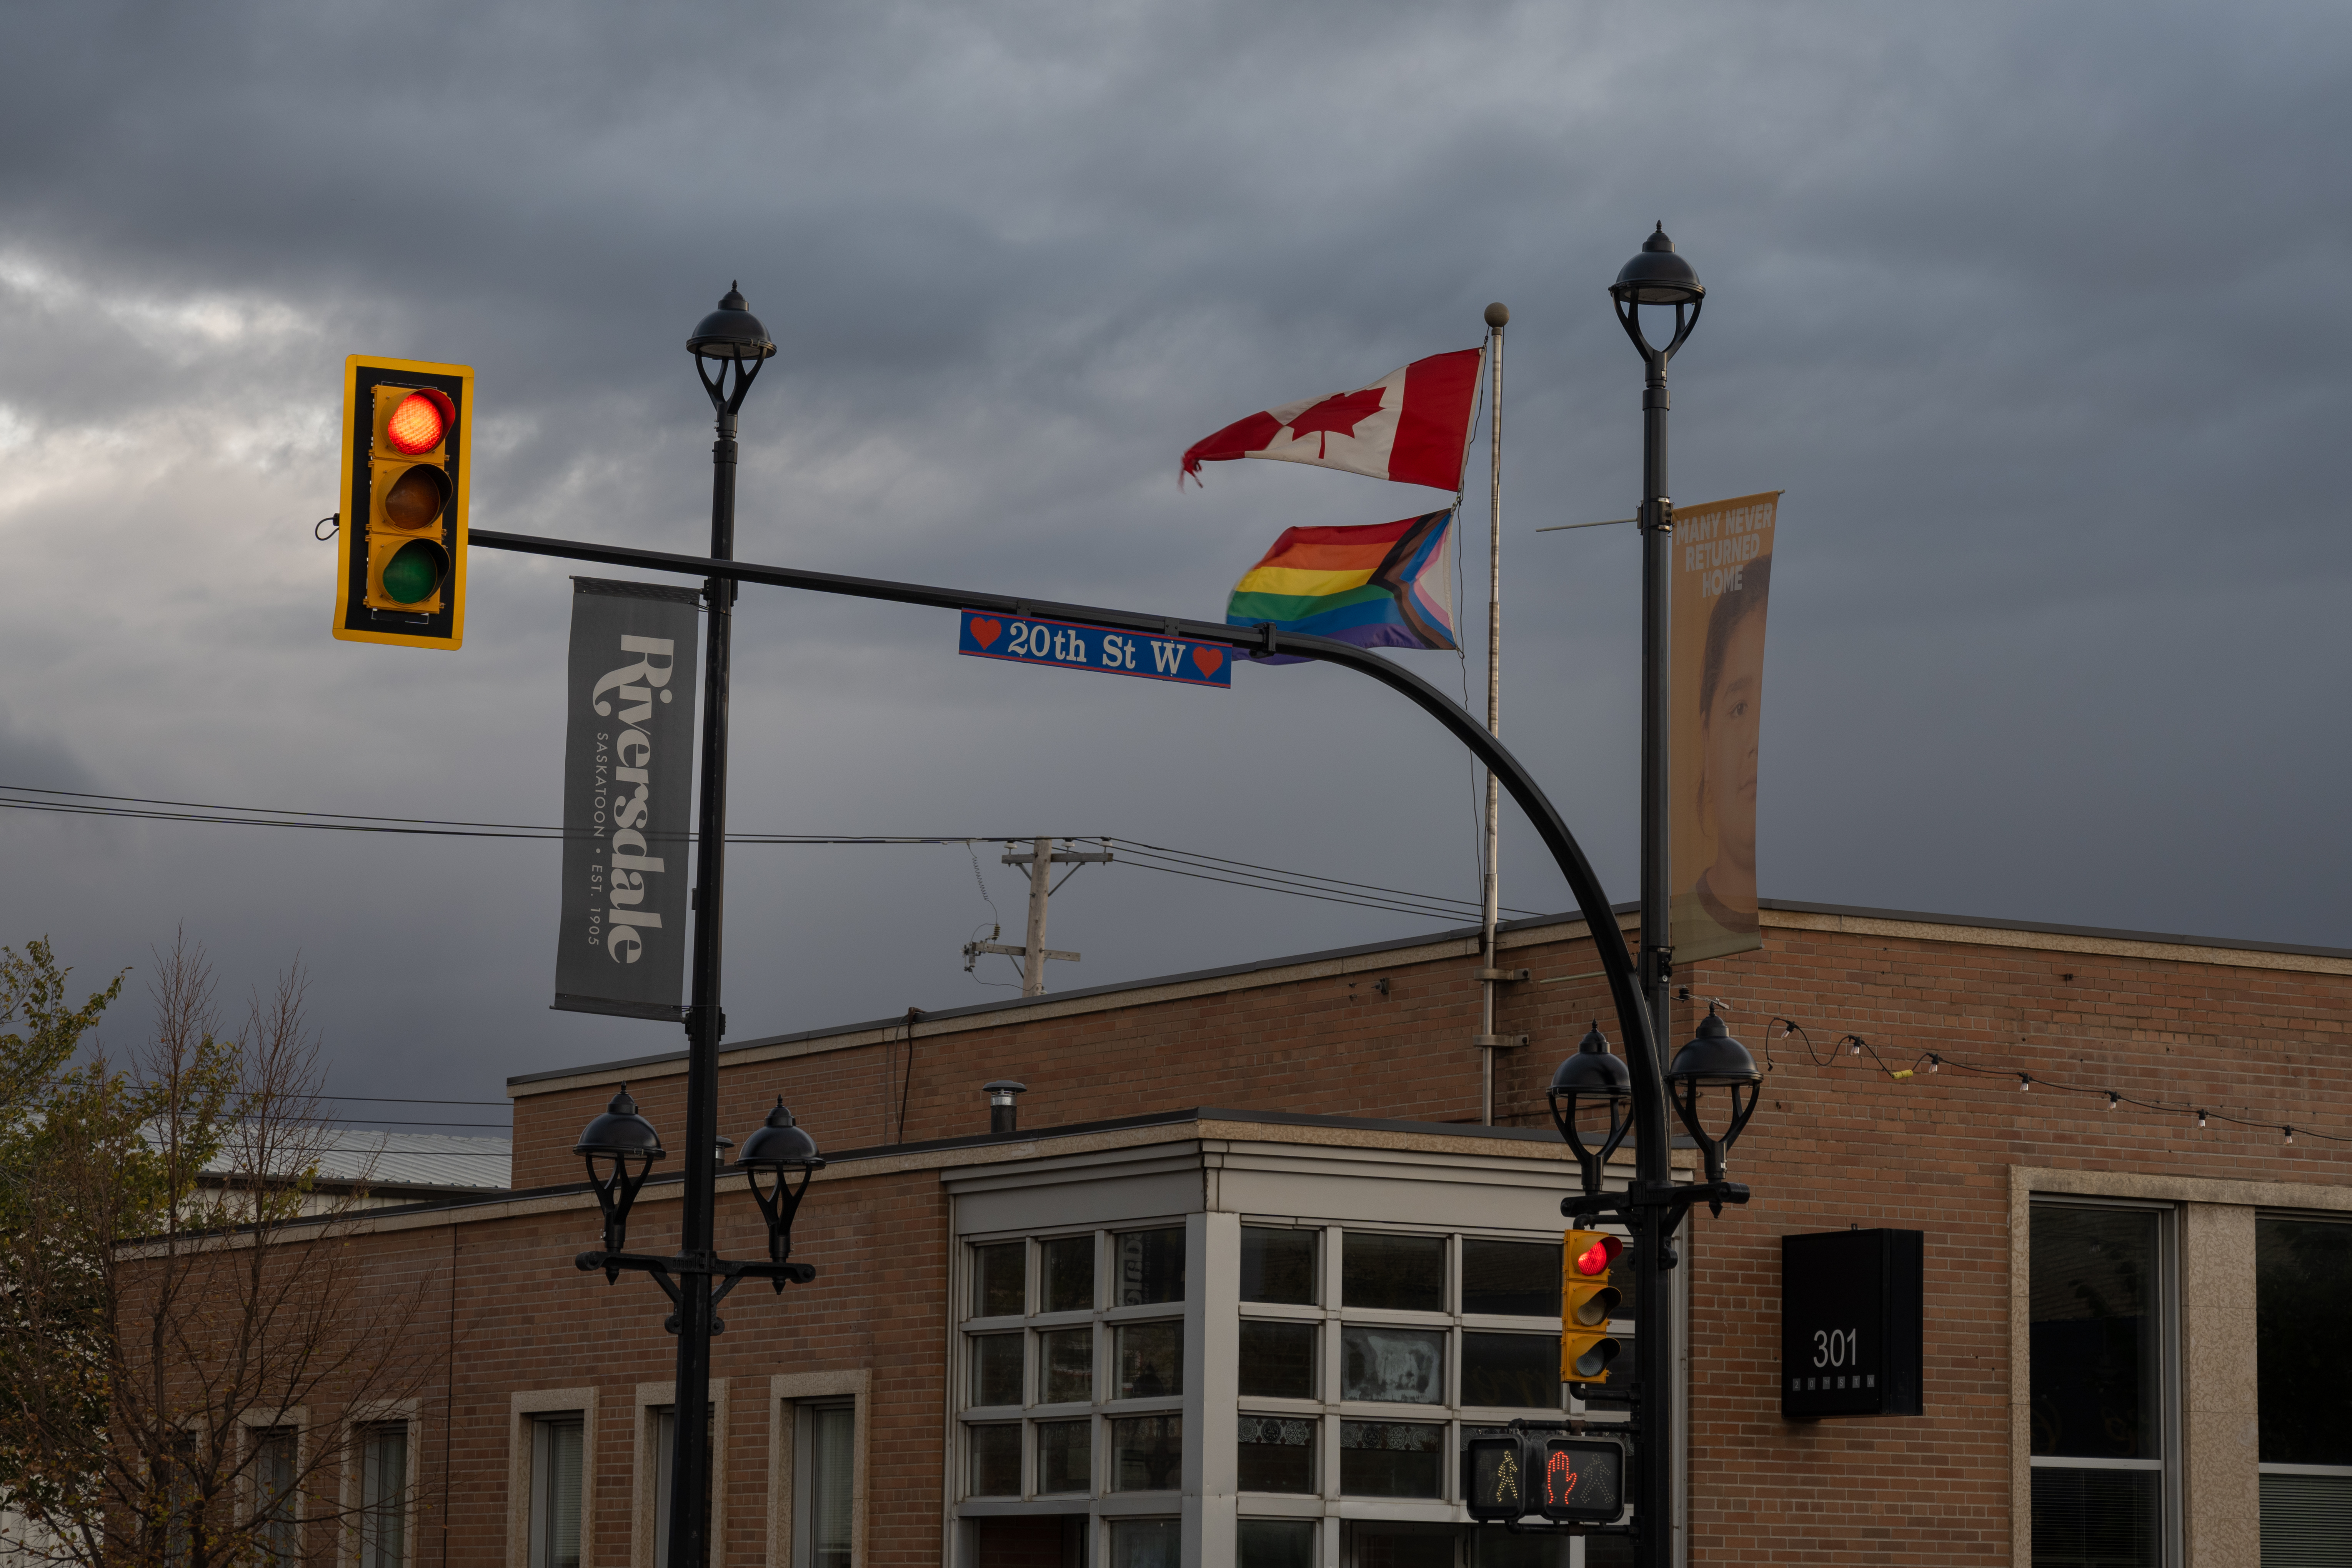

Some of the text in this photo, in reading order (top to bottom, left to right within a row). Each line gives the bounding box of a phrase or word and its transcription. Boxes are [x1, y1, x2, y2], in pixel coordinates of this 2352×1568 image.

[1676, 503, 1773, 545] MANY NEVER
[1686, 533, 1760, 572] RETURNED
[1702, 565, 1743, 598] HOME
[1008, 623, 1186, 674] 20th St W
[593, 634, 674, 963] Riversdale
[588, 733, 608, 945] SASKATOON EST. 1905
[1813, 1328, 1856, 1368] 301
